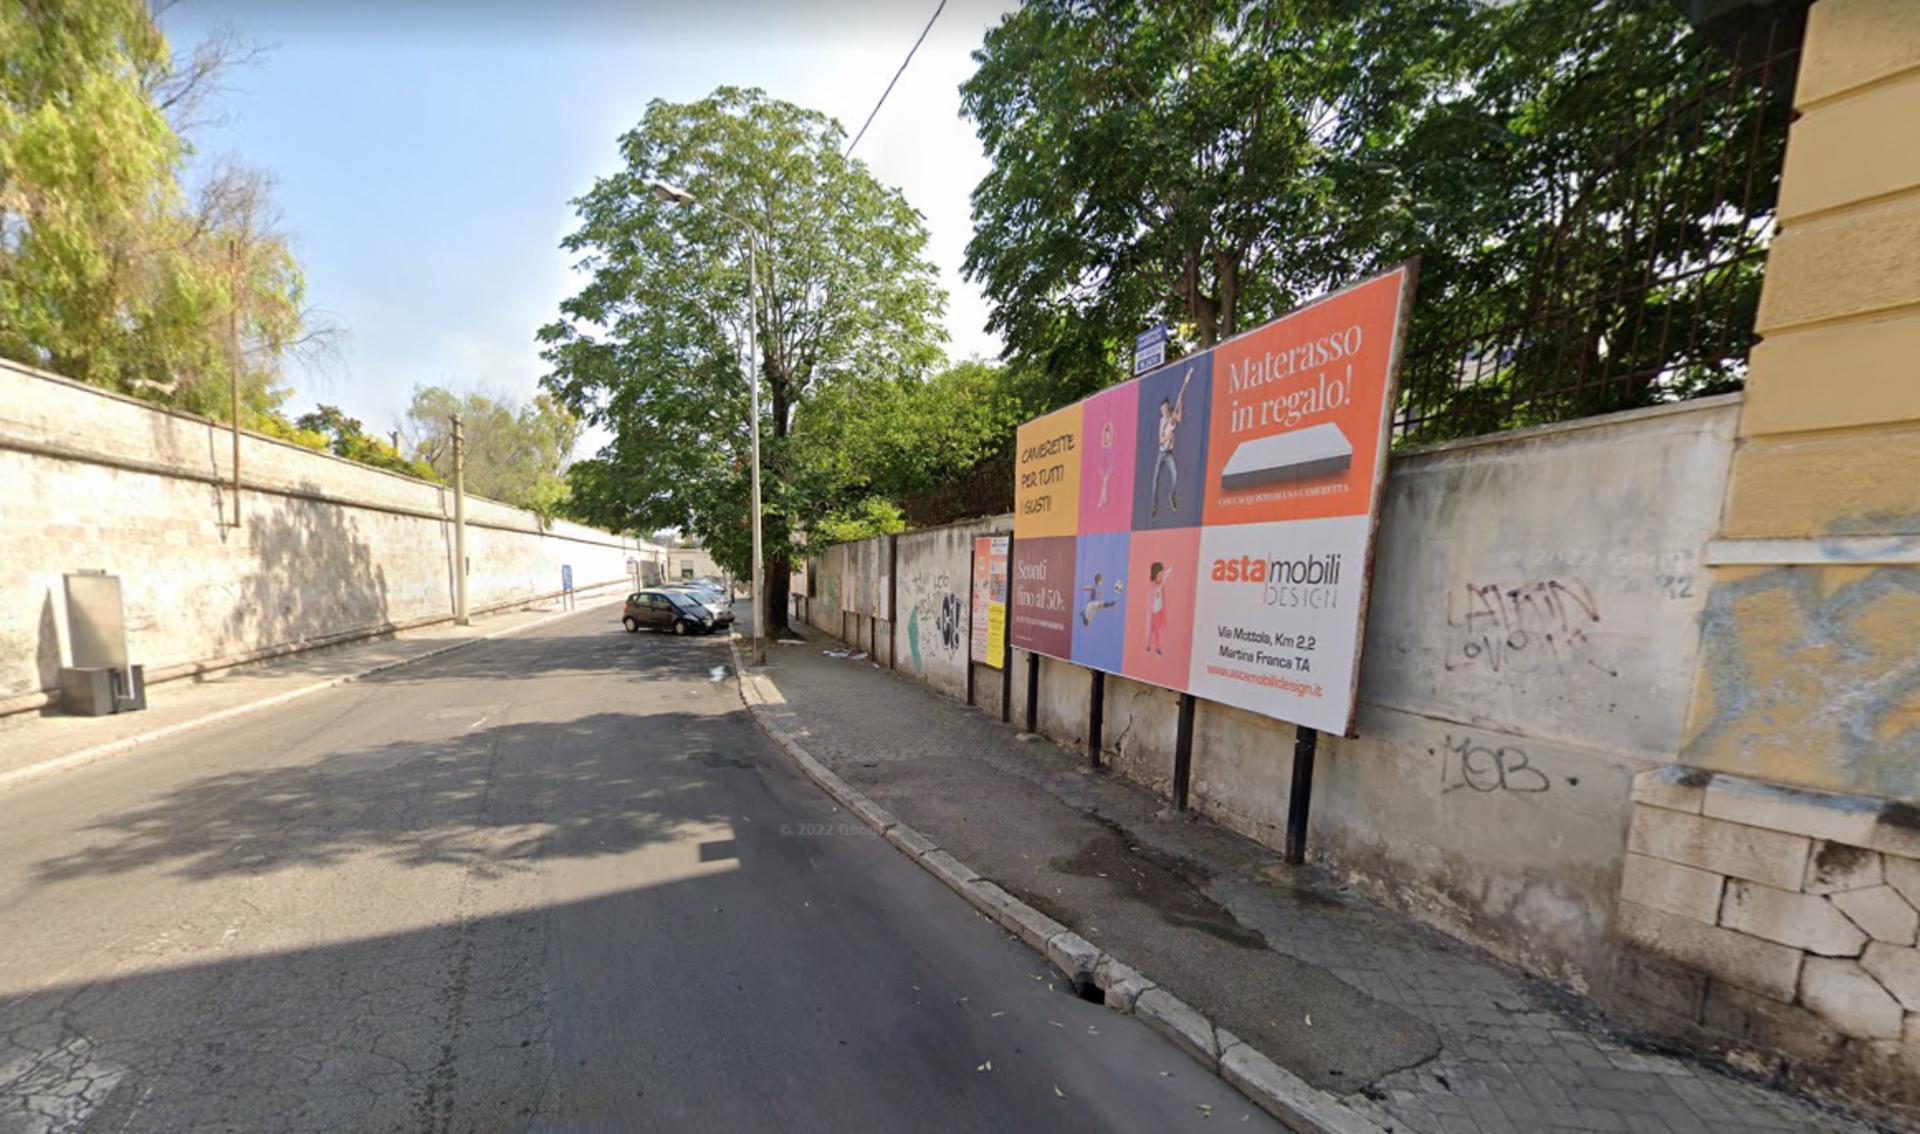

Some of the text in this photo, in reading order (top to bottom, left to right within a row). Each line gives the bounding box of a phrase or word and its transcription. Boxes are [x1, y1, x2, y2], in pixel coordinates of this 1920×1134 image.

[1227, 325, 1363, 395] Materasso
[1230, 363, 1353, 433] in regalo!
[1021, 433, 1075, 465] CAMERETTE
[1022, 464, 1065, 489] PER TUTTI
[1018, 559, 1047, 581] Sconti
[1211, 553, 1341, 585] asta mobili
[1016, 586, 1035, 608] fino
[1036, 587, 1045, 610] al
[1264, 586, 1339, 609] DESIGN
[1217, 625, 1233, 639] Via
[1234, 627, 1273, 647] Mottola,
[1274, 632, 1294, 648] Km
[1219, 644, 1311, 673] Martina Franca TA
